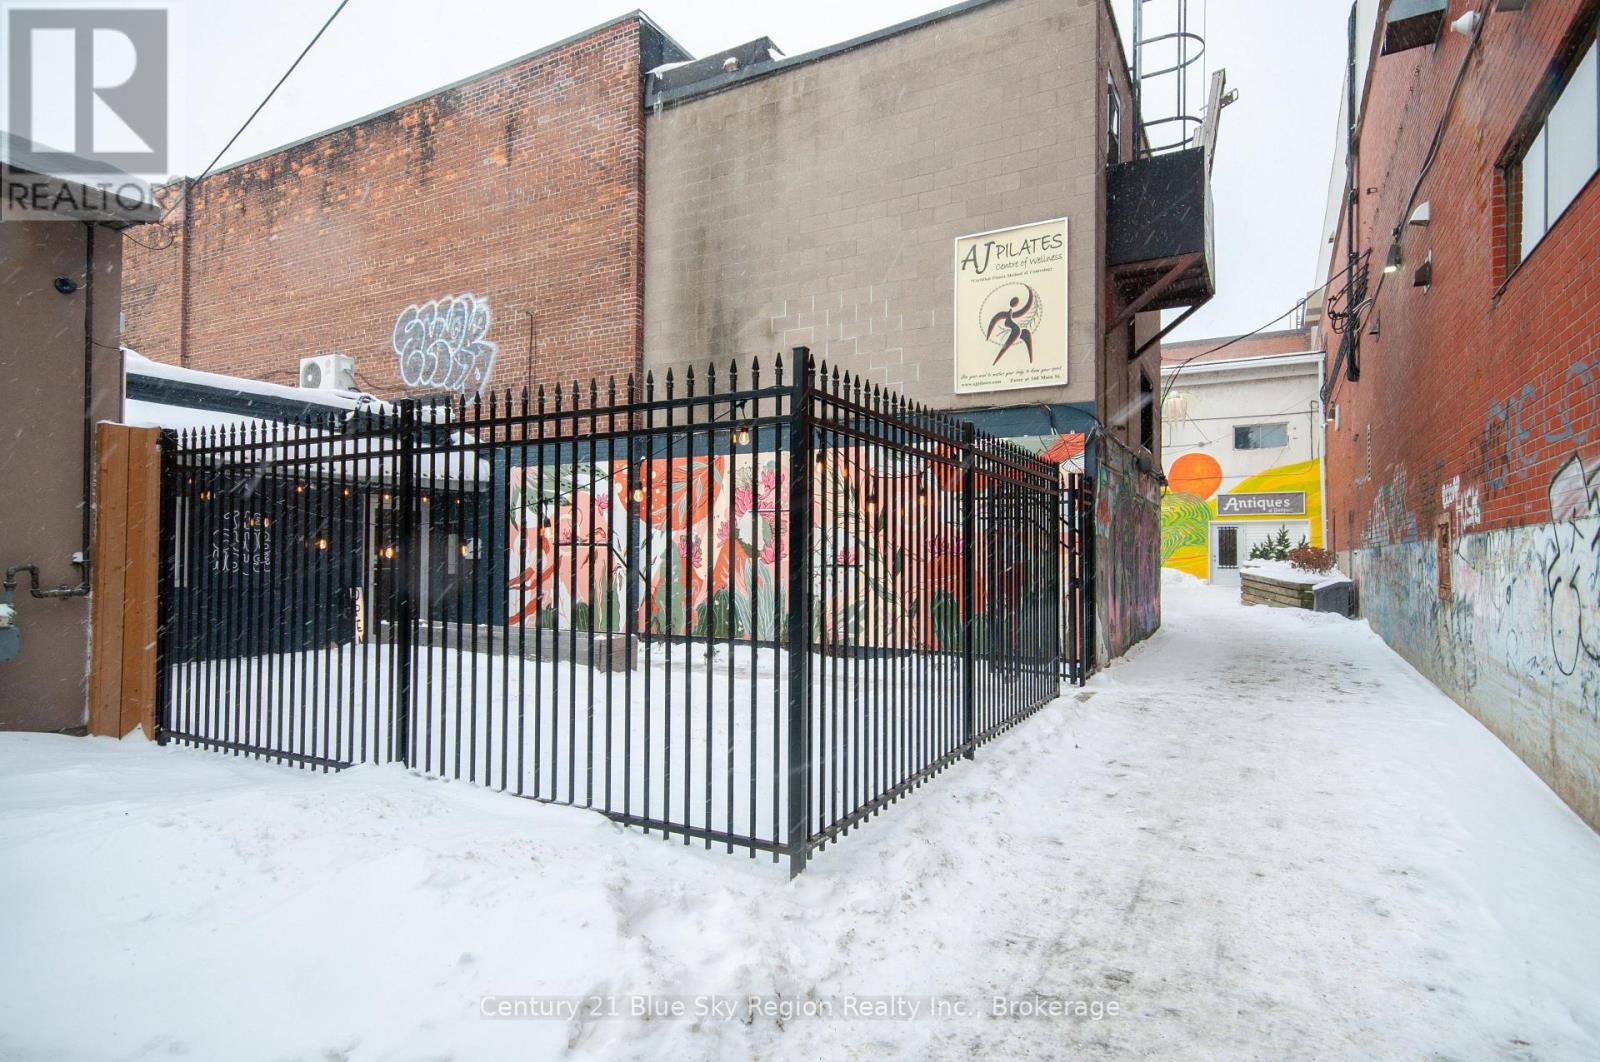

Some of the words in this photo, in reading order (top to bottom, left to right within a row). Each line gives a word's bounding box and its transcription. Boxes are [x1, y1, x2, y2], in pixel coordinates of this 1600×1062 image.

[961, 241, 995, 274] AJ
[996, 234, 1063, 259] PILATES
[1020, 257, 1028, 268] of
[1223, 497, 1290, 512] Antiques
